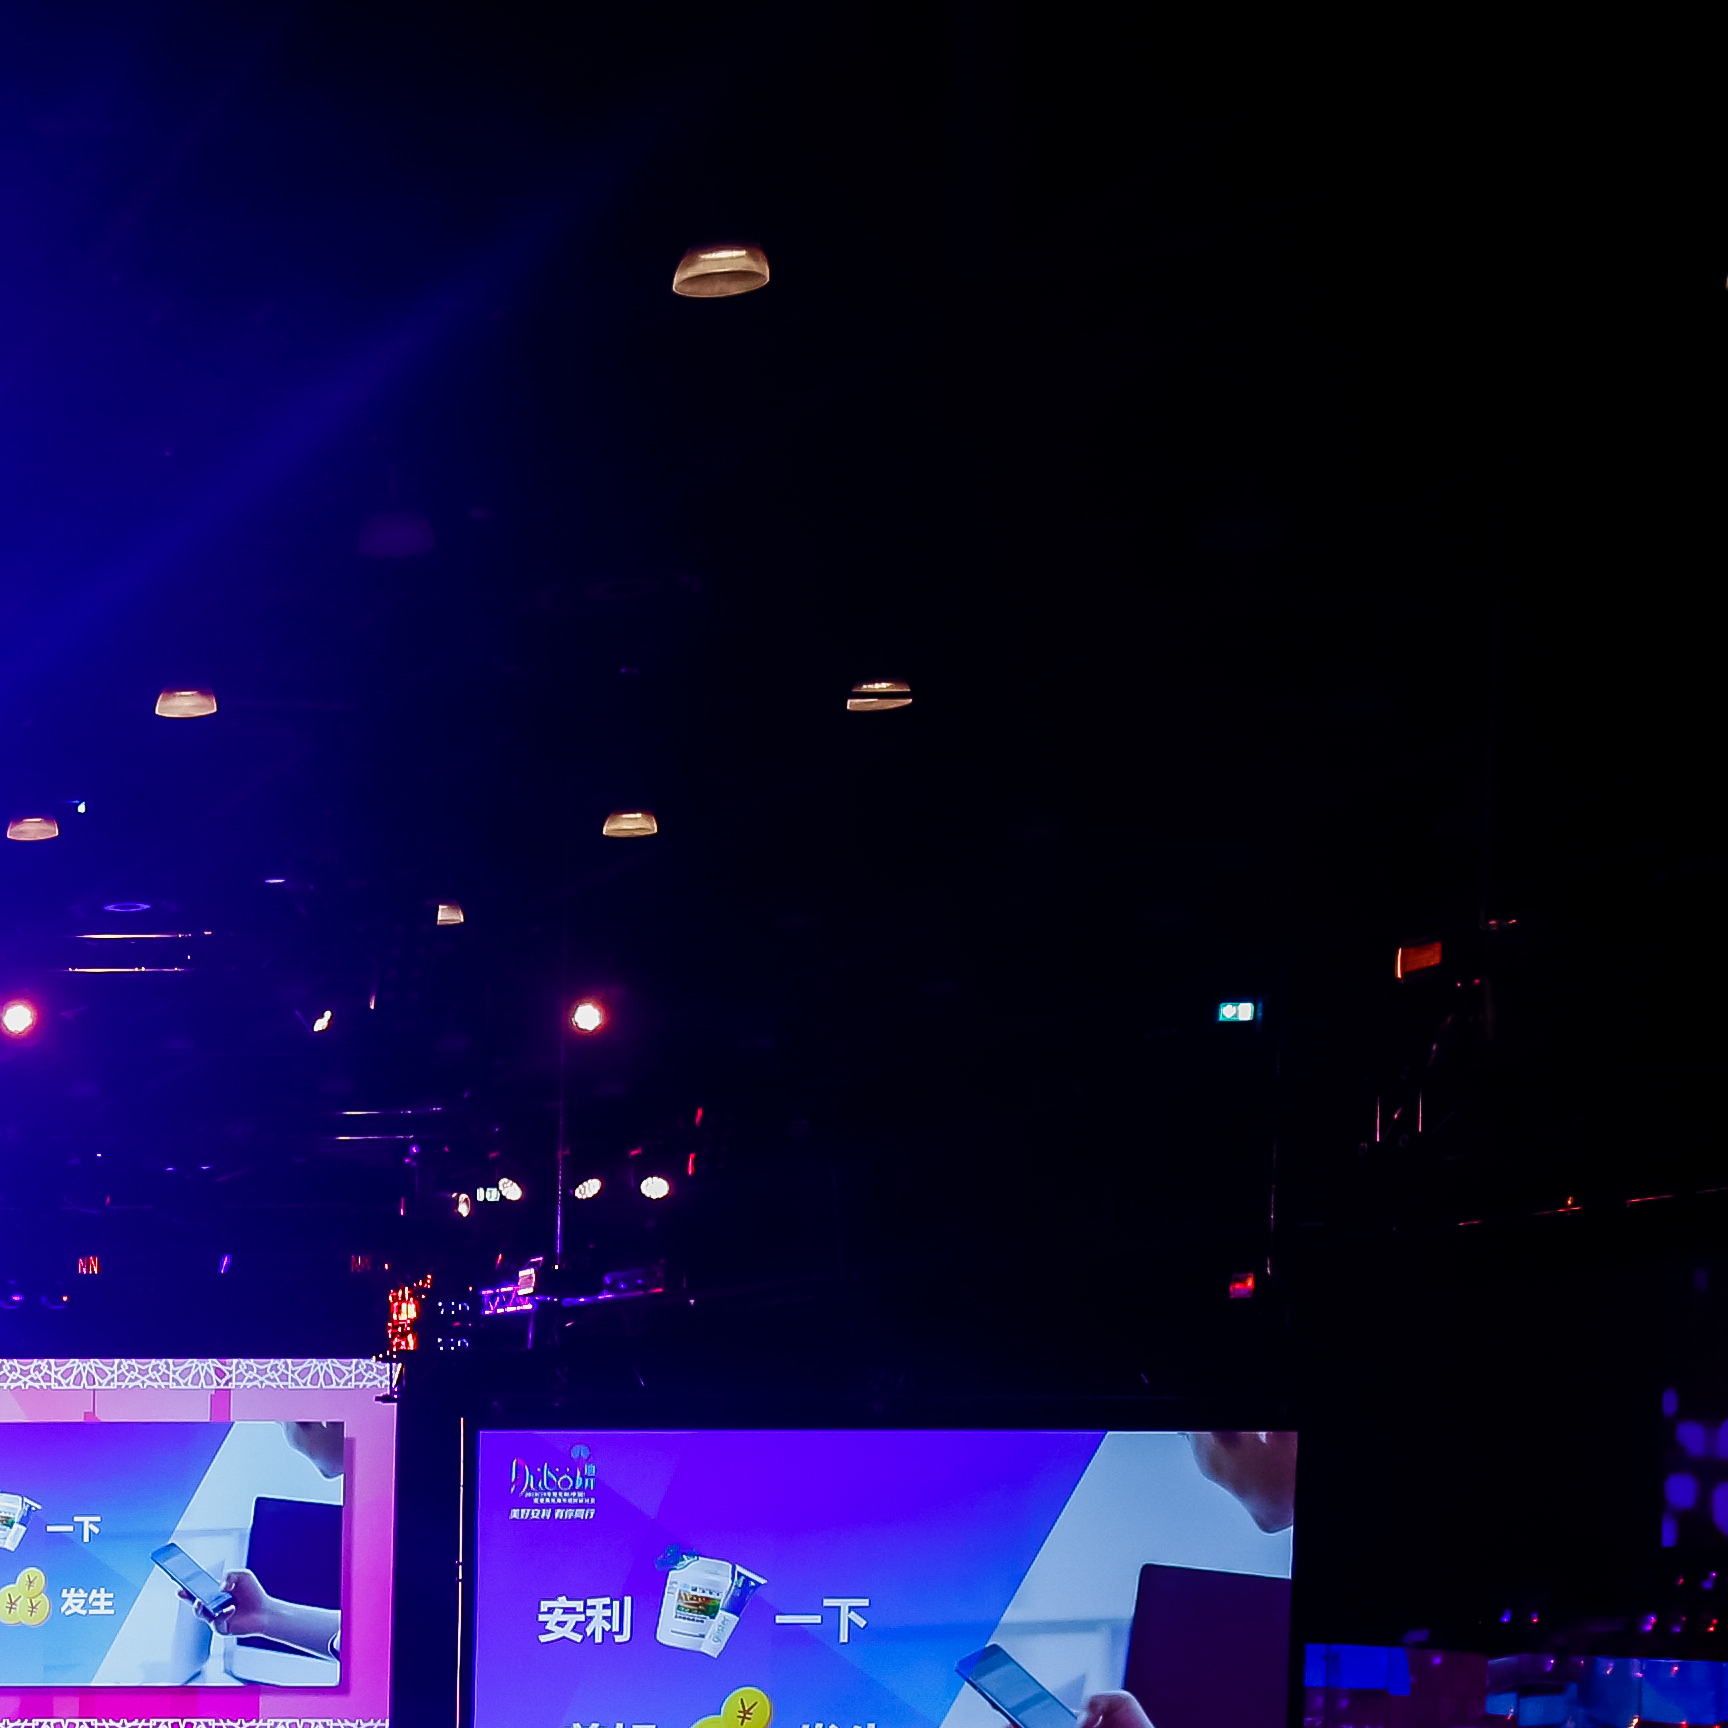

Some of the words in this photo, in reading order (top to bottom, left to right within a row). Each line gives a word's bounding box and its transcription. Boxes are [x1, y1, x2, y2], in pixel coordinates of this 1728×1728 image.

[46, 1515, 102, 1543] 一下
[60, 1587, 115, 1616] 发生
[538, 1595, 632, 1644] 安利
[775, 1597, 870, 1644] 一下
